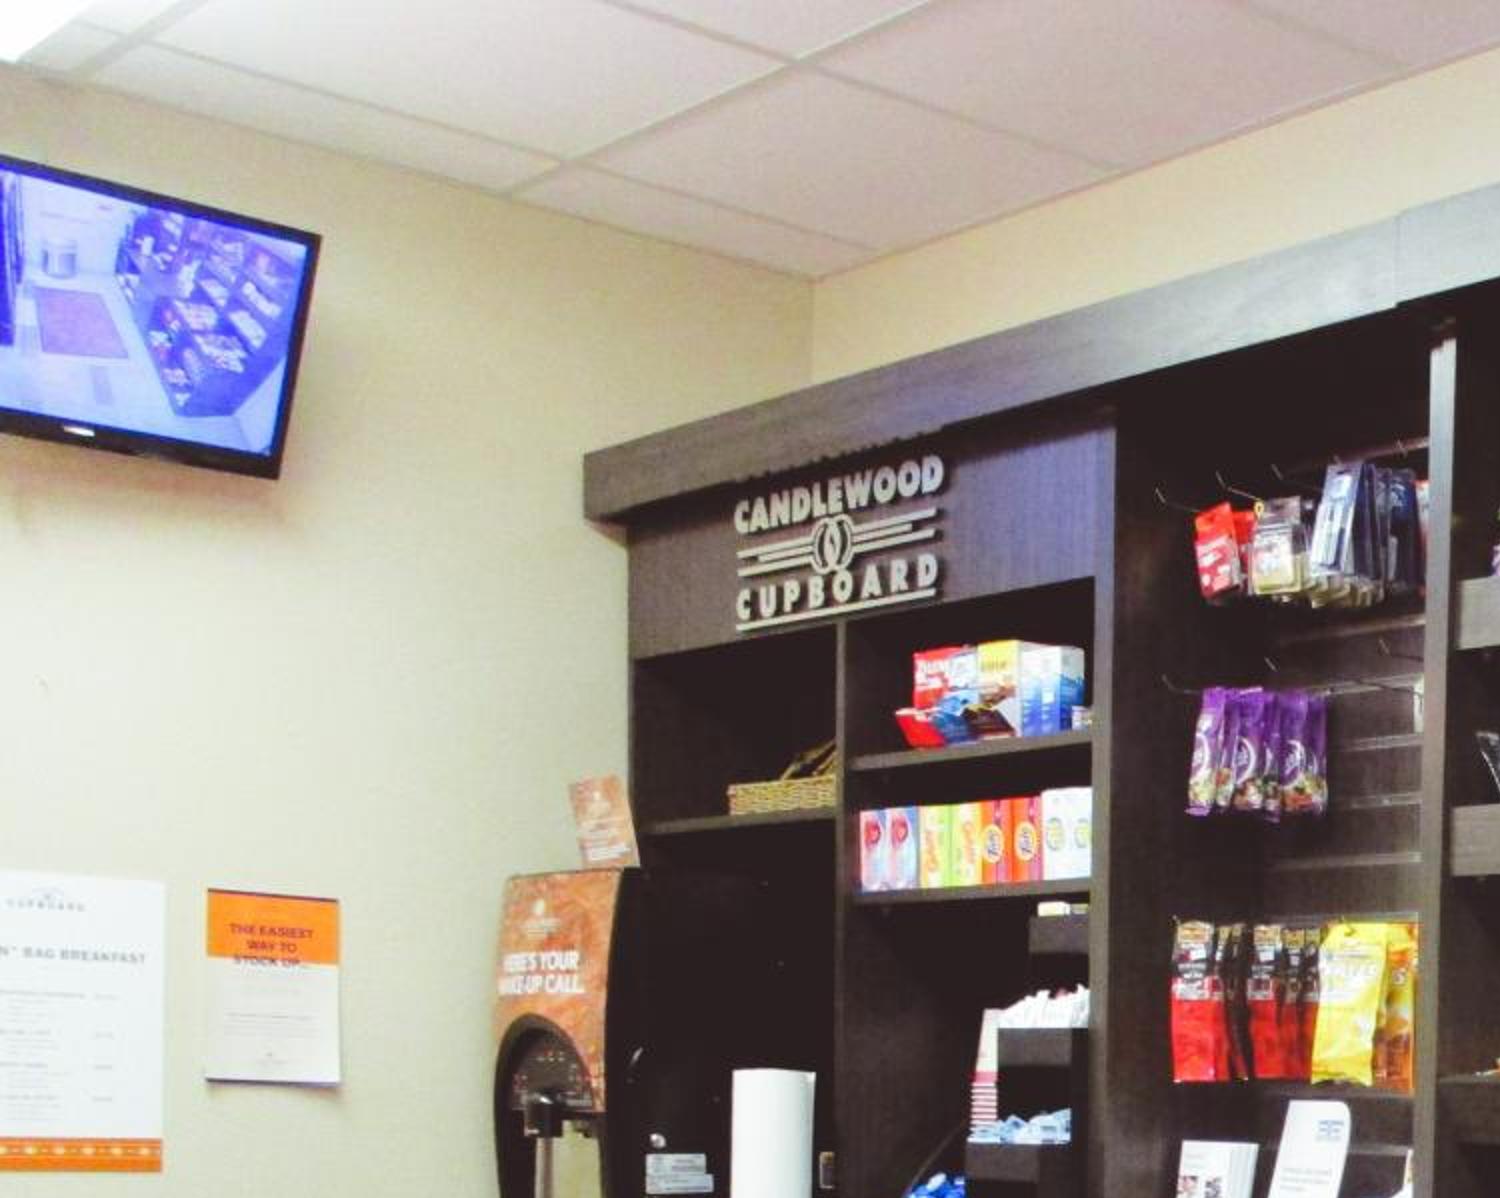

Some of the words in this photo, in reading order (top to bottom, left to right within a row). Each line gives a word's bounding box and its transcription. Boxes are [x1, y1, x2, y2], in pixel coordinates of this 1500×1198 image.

[734, 454, 944, 534] CANDLEWOOD
[735, 553, 938, 620] CUPBOARD
[229, 922, 255, 934] THE
[259, 925, 314, 939] EASIEST
[22, 946, 56, 960] BAG
[60, 947, 146, 965] BREAKFAST
[245, 939, 275, 950] WAY
[280, 942, 298, 953] TO
[539, 949, 579, 971] YOUR
